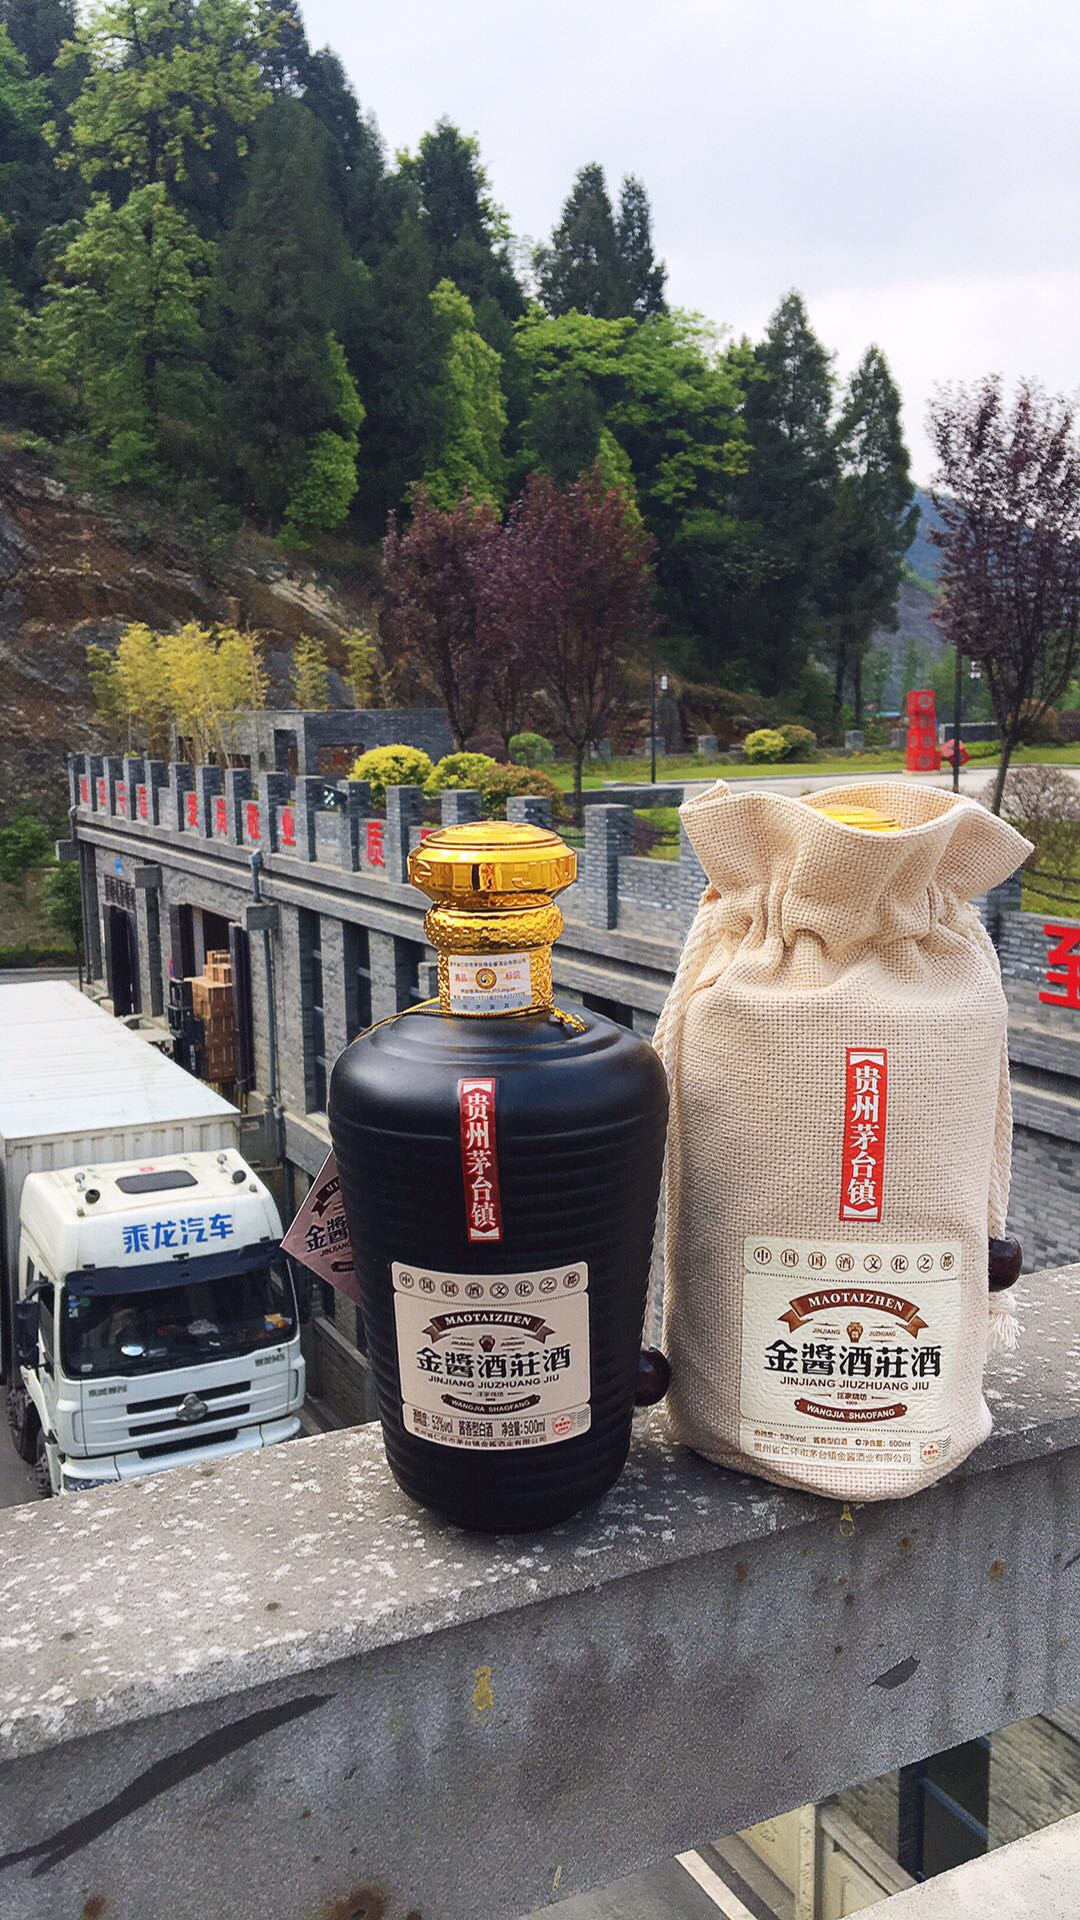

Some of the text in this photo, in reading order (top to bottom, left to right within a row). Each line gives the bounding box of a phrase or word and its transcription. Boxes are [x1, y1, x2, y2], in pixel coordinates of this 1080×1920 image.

[847, 1065, 881, 1205] 贵州茅台镇
[465, 1092, 496, 1227] 贵州茅台镇
[122, 1213, 234, 1254] 乘龙汽车
[753, 1246, 955, 1273] 中国国酒文化之都
[808, 1293, 905, 1312] MAOTAIZHEN
[444, 1313, 532, 1326] MAOTAIZHEN
[812, 1327, 840, 1335] JINJIANG
[416, 1343, 571, 1379] 金醬酒莊酒
[764, 1339, 942, 1378] 金醬酒莊酒
[428, 1374, 560, 1389] JINJIANG JIUZHUANG JIU
[780, 1376, 930, 1391] JINJIANG JIUZHUANG JIU
[451, 1400, 531, 1413] WANGJIA SHAOFANG
[806, 1404, 896, 1420] WANGJIA SHAOFANG
[780, 1432, 807, 1443] 53%vol
